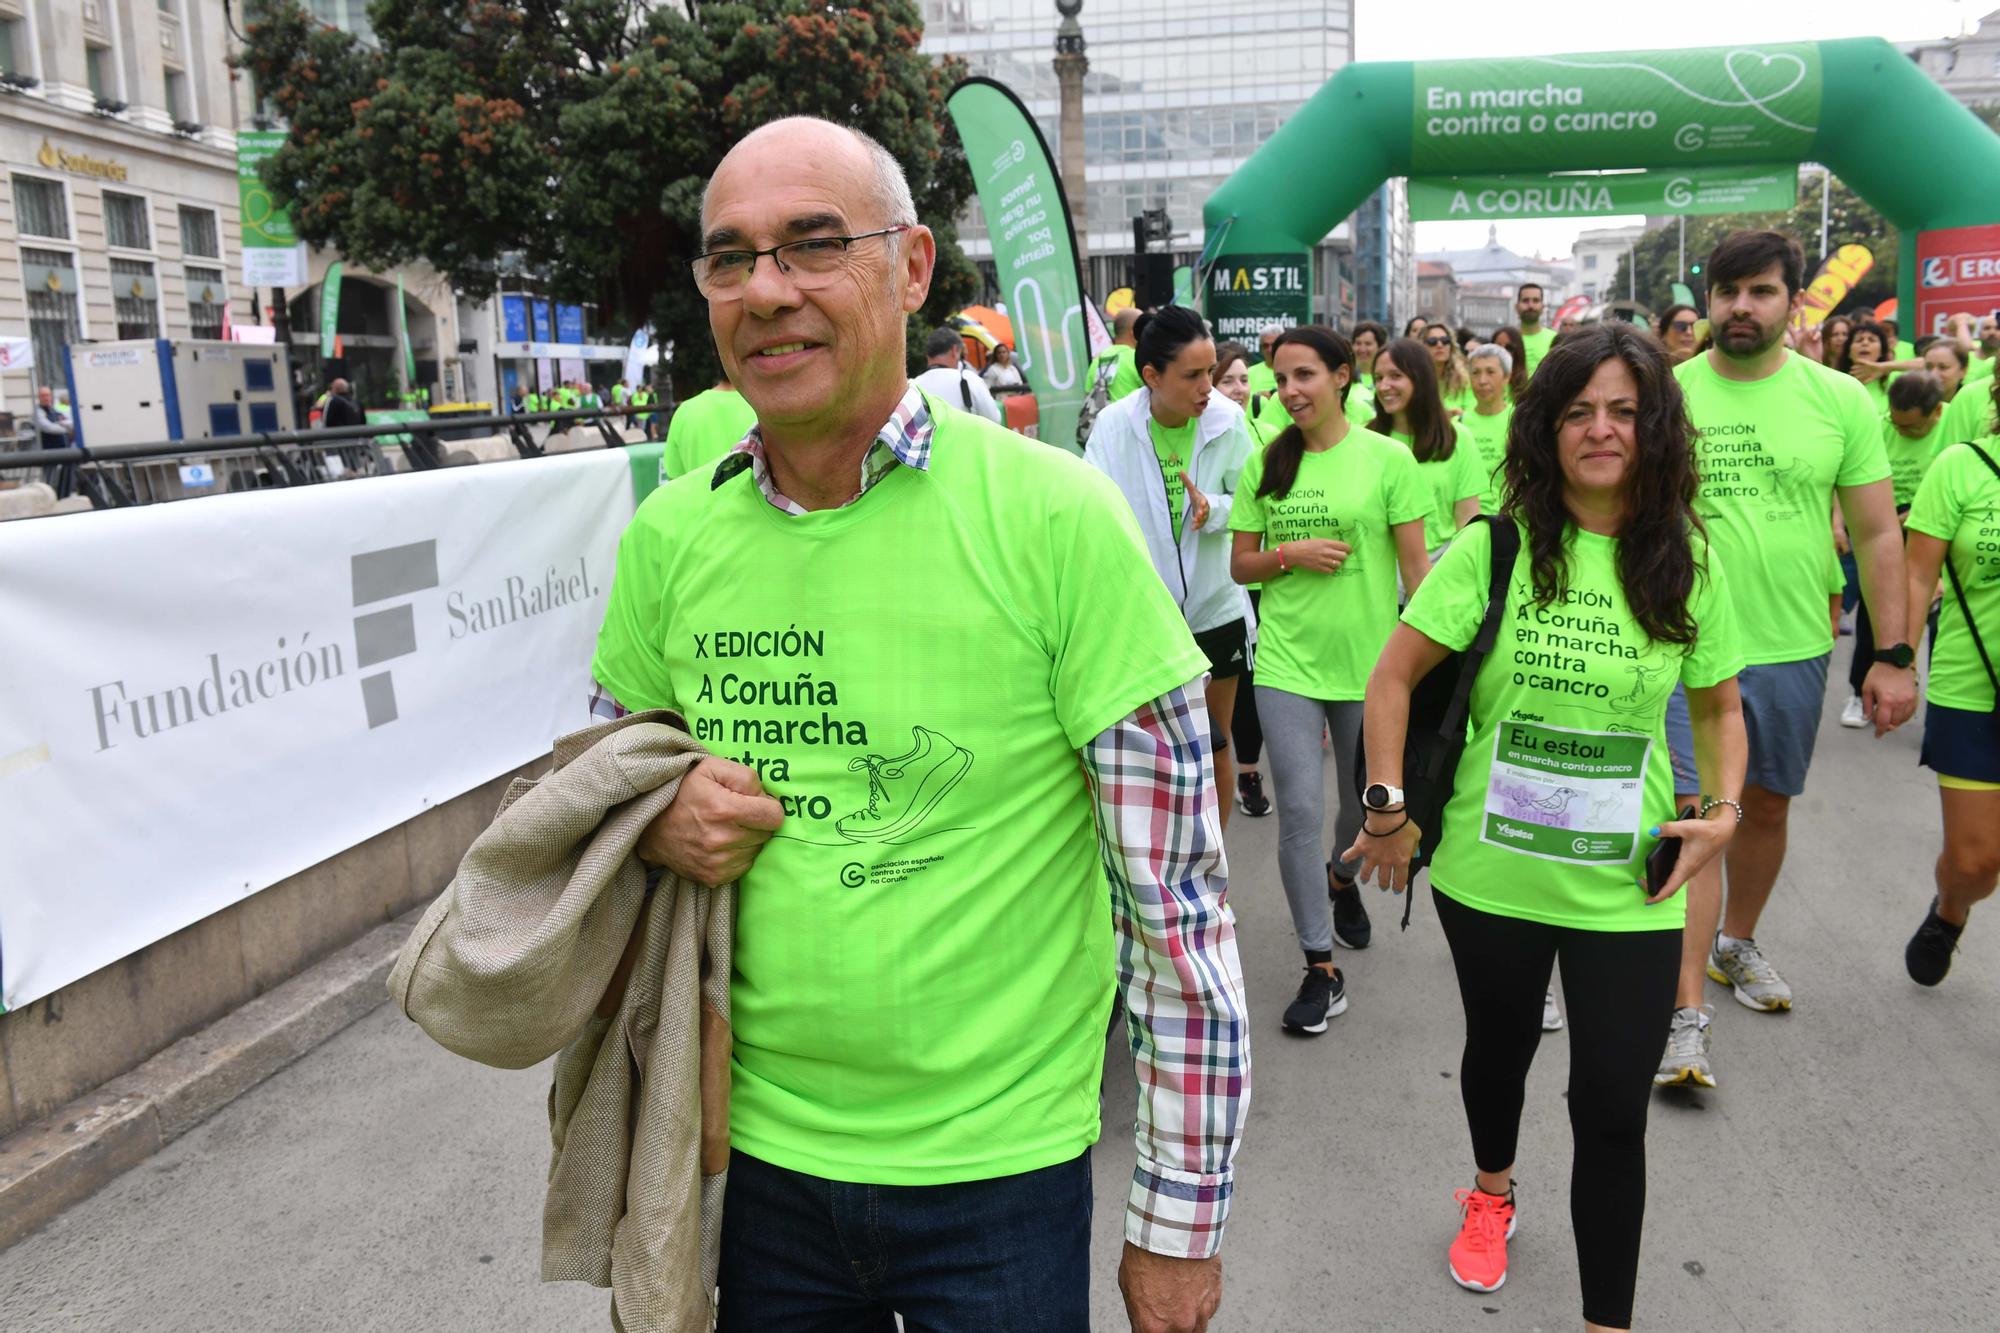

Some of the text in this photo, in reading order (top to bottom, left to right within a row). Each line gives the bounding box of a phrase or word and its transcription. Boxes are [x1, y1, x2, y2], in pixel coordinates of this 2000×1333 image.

[1427, 83, 1584, 110] En marcha
[1427, 109, 1658, 136] contra o cancro
[1449, 182, 1614, 215] A CORUÑA
[1214, 267, 1303, 291] MASTIL
[1702, 440, 1762, 454] Coruña
[1696, 454, 1775, 468] n marcha
[1698, 470, 1741, 483] ontra
[1702, 486, 1760, 498] cancro
[1278, 503, 1328, 515] Coruña
[1272, 516, 1339, 530] en marcha
[1517, 604, 1620, 637] A Coruña
[694, 624, 824, 659] X EDICIÓN
[1516, 628, 1639, 660] en marcha
[1514, 650, 1586, 673] contra
[84, 633, 347, 754] Fundación
[696, 673, 838, 706] A Coruña
[1513, 672, 1610, 698] o cancro
[696, 712, 869, 746] en marcha
[1510, 728, 1605, 759] Eu estou
[1508, 750, 1520, 760] en
[1522, 753, 1560, 768] marcha
[1561, 761, 1594, 773] contra
[1603, 764, 1633, 773] cancro
[870, 855, 945, 870] asociación española
[870, 868, 895, 877] contra
[902, 865, 927, 874] cancro
[881, 875, 908, 884] Coruña
